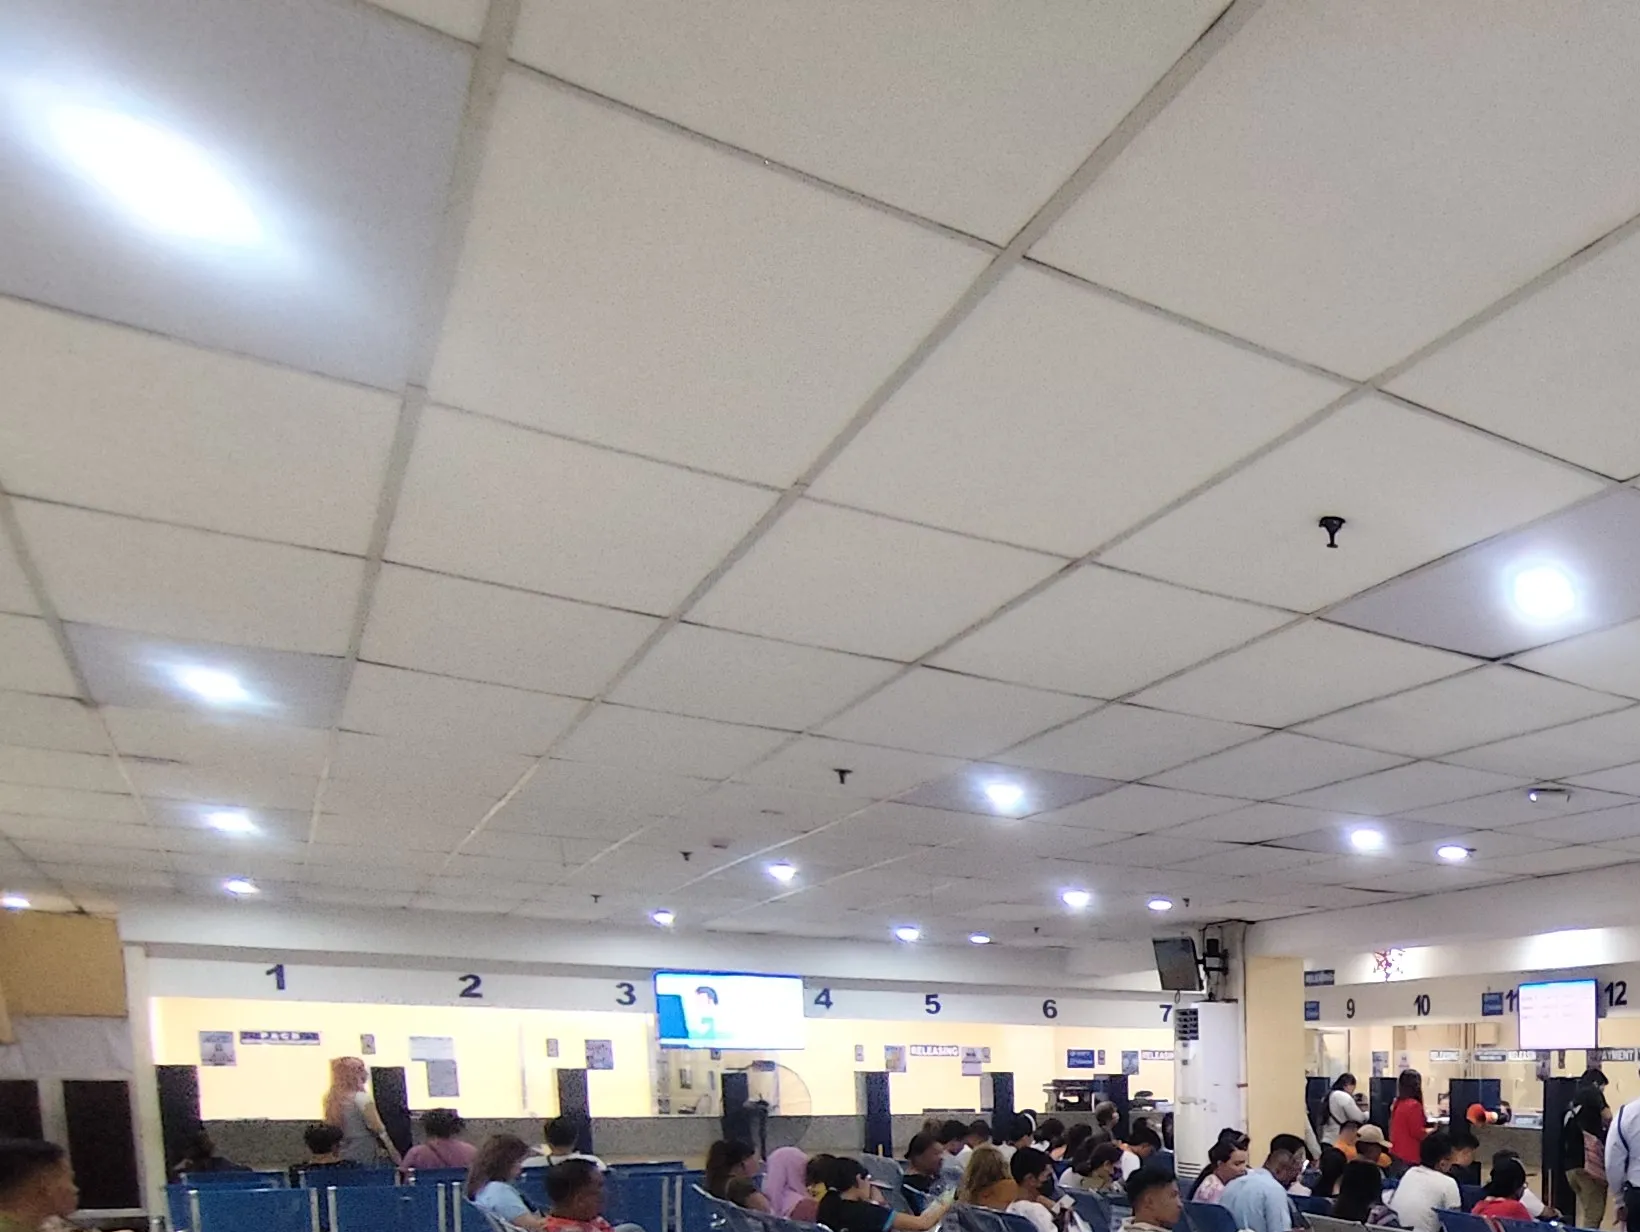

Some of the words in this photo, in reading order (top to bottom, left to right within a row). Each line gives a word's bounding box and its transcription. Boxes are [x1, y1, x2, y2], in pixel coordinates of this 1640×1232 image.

[266, 964, 285, 990] 1
[459, 974, 483, 999] 2
[615, 983, 637, 1005] 3
[814, 988, 833, 1009] 4
[925, 994, 941, 1014] 5
[1604, 981, 1628, 1007] 12
[1043, 999, 1058, 1019] 6
[1159, 1004, 1173, 1022] 7
[1346, 998, 1356, 1019] 9
[1413, 994, 1431, 1016] 10
[910, 1046, 959, 1057] RELEASING
